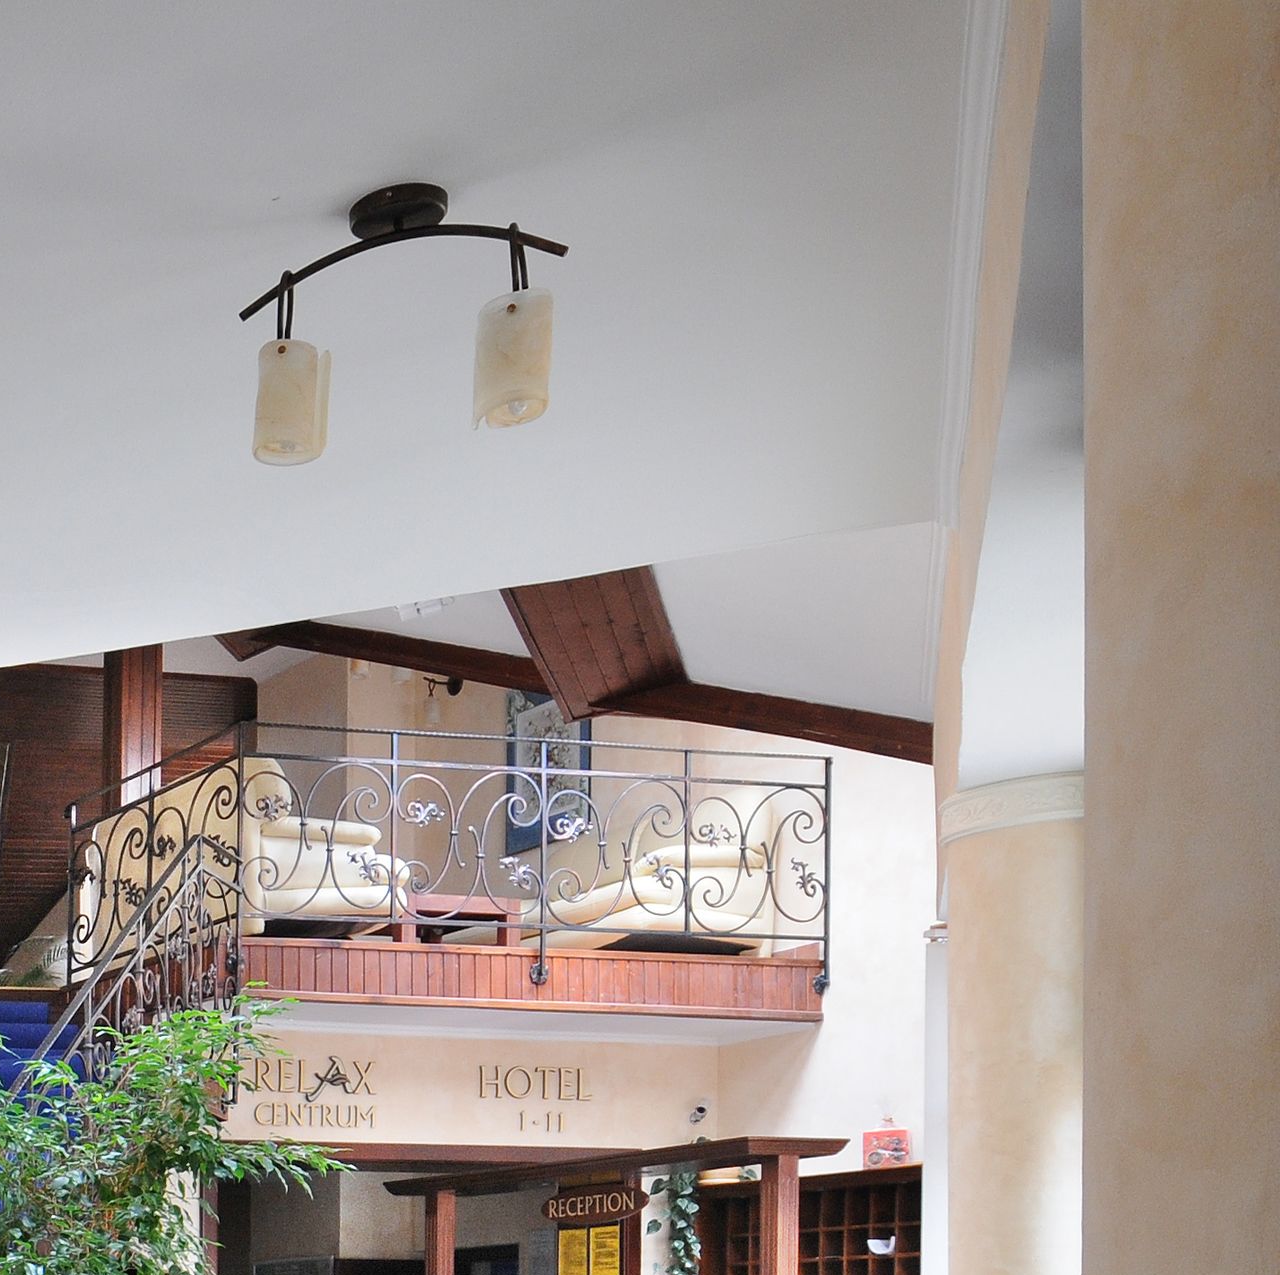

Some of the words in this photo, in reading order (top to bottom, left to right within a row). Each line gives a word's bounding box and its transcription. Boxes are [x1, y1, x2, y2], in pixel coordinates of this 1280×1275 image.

[254, 1055, 377, 1102] RELAX
[478, 1065, 593, 1101] HOTEL
[253, 1102, 377, 1128] CENTRUM
[548, 1191, 636, 1219] RECEPTION
